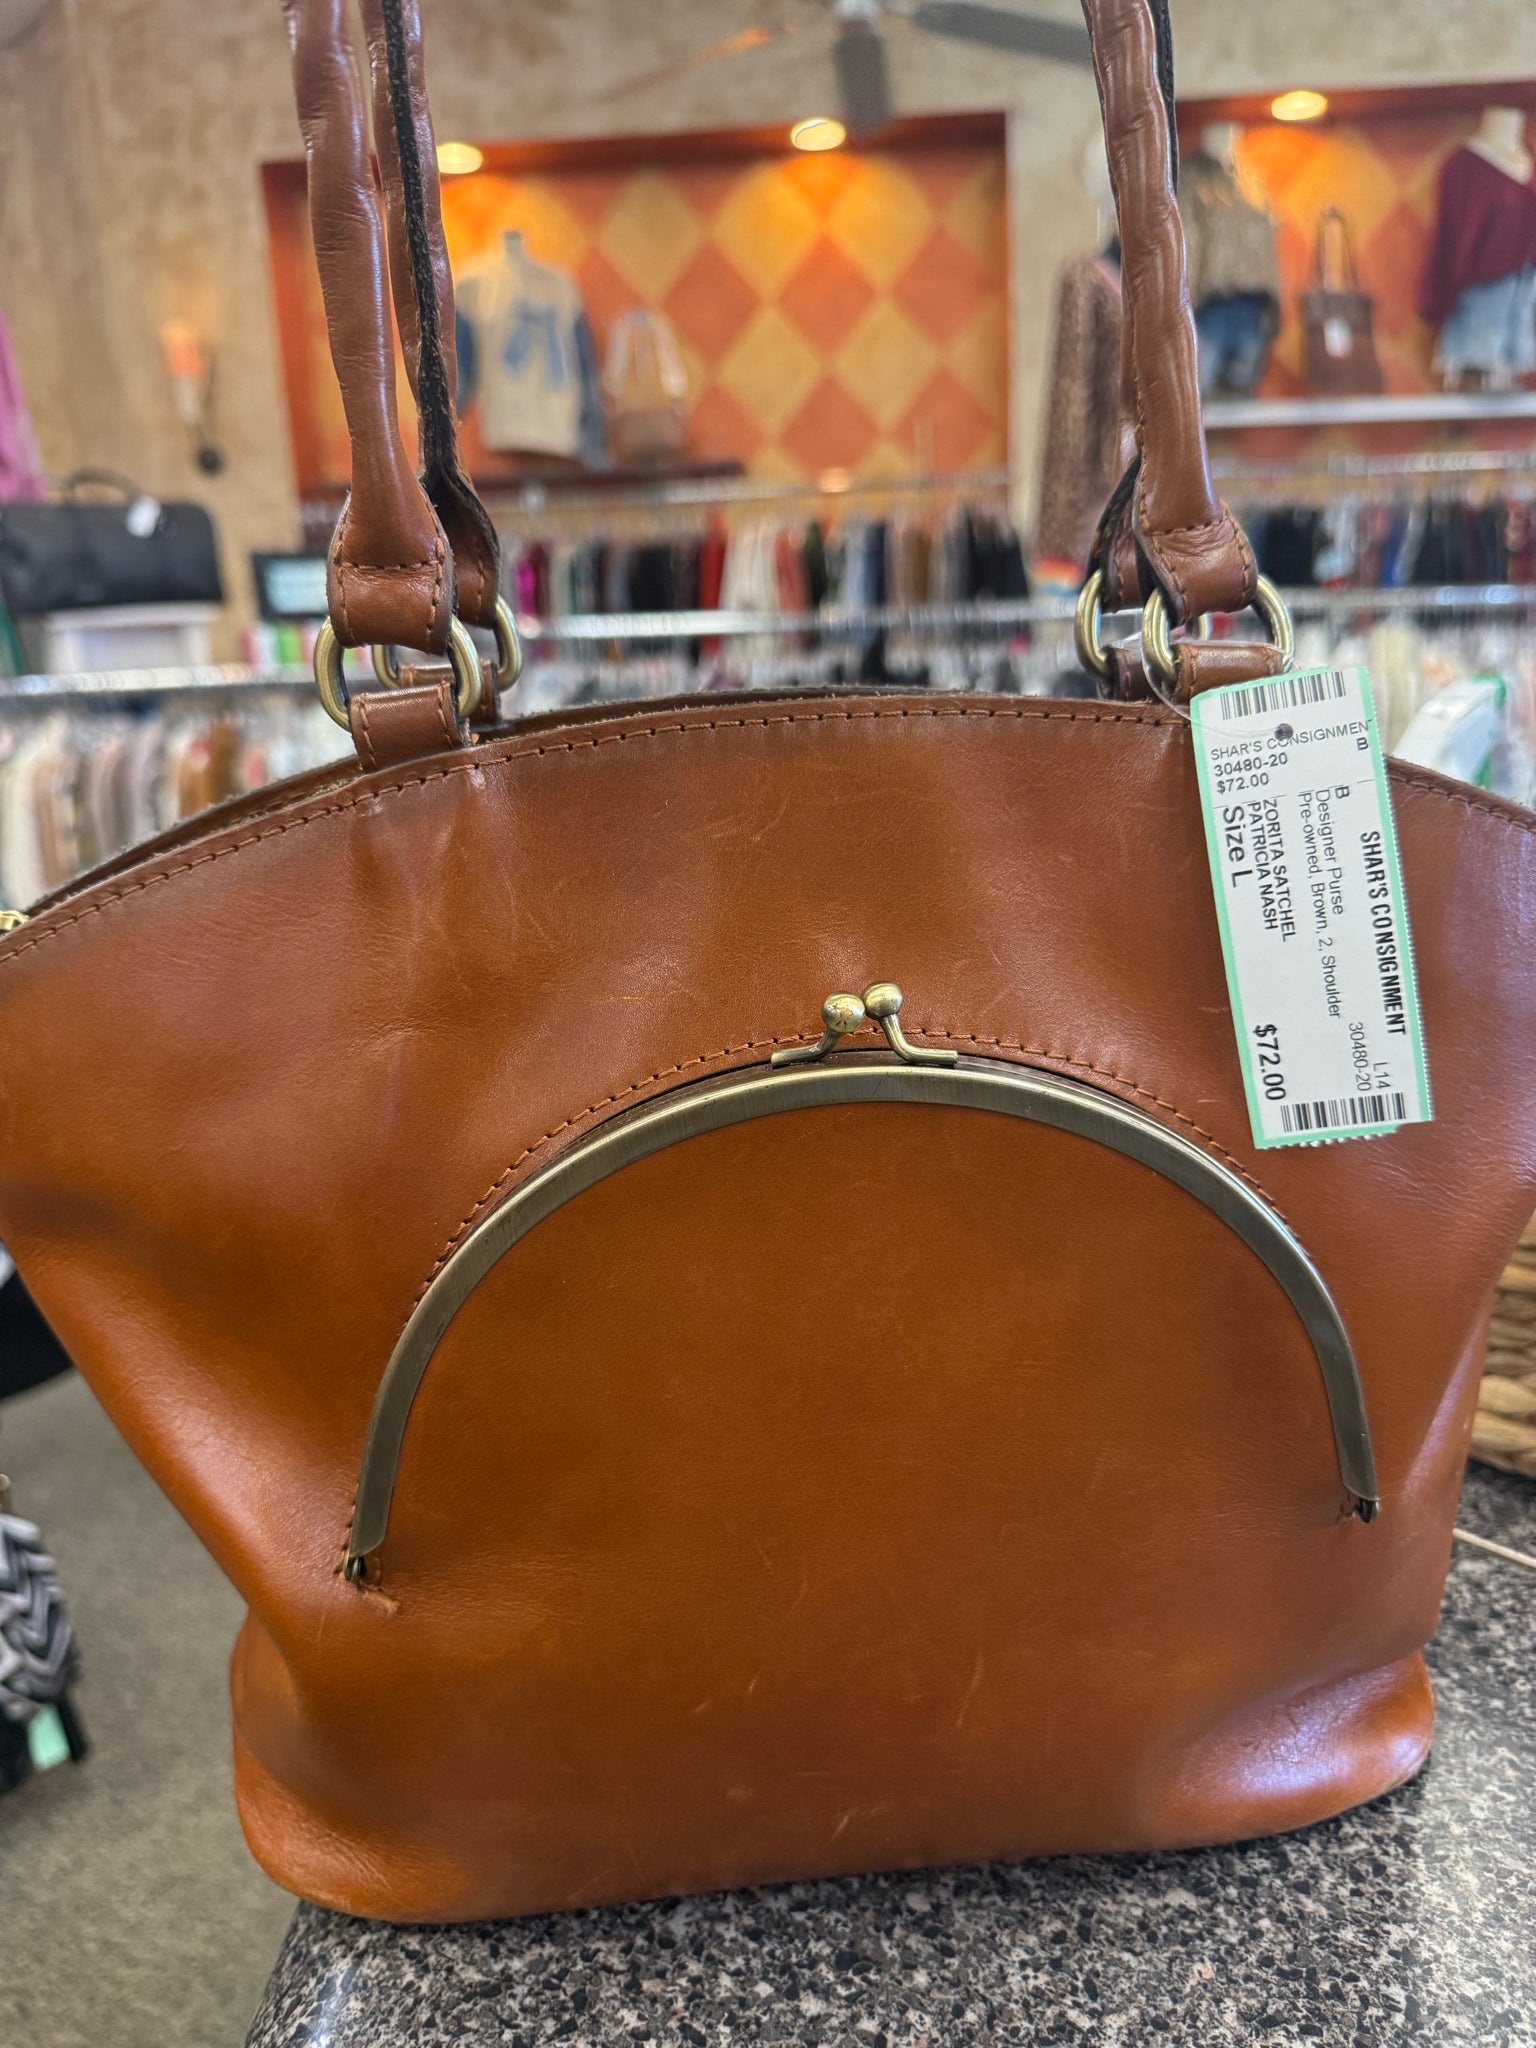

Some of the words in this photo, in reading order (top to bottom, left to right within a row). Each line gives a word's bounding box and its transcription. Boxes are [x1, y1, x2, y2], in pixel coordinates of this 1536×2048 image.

[1210, 740, 1263, 760] SHAR'S
[1266, 718, 1374, 750] CONSIGNMEN
[1213, 752, 1288, 777] 30480-20
[1356, 737, 1369, 751] B
[1216, 772, 1270, 795] $72.00
[1334, 785, 1350, 800] B
[1222, 805, 1247, 863] Size
[1247, 801, 1271, 881] PATRICIA
[1262, 799, 1285, 862] ZORITA
[1298, 792, 1323, 879] Pre-owned,
[1315, 789, 1337, 863] Designer
[1327, 867, 1344, 915] Purse
[1231, 869, 1253, 888] L
[1359, 830, 1389, 899] SHAR'S
[1258, 884, 1279, 930] NASH
[1272, 865, 1297, 943] SATCHEL
[1310, 882, 1329, 934] Brown,
[1318, 937, 1333, 952] 2,
[1370, 903, 1407, 1035] CONSIGNMENT
[1321, 955, 1341, 1019] Shoulder
[1252, 1023, 1287, 1101] $72.00
[1348, 1021, 1372, 1092] 30480-20
[1373, 1061, 1391, 1089] L14
